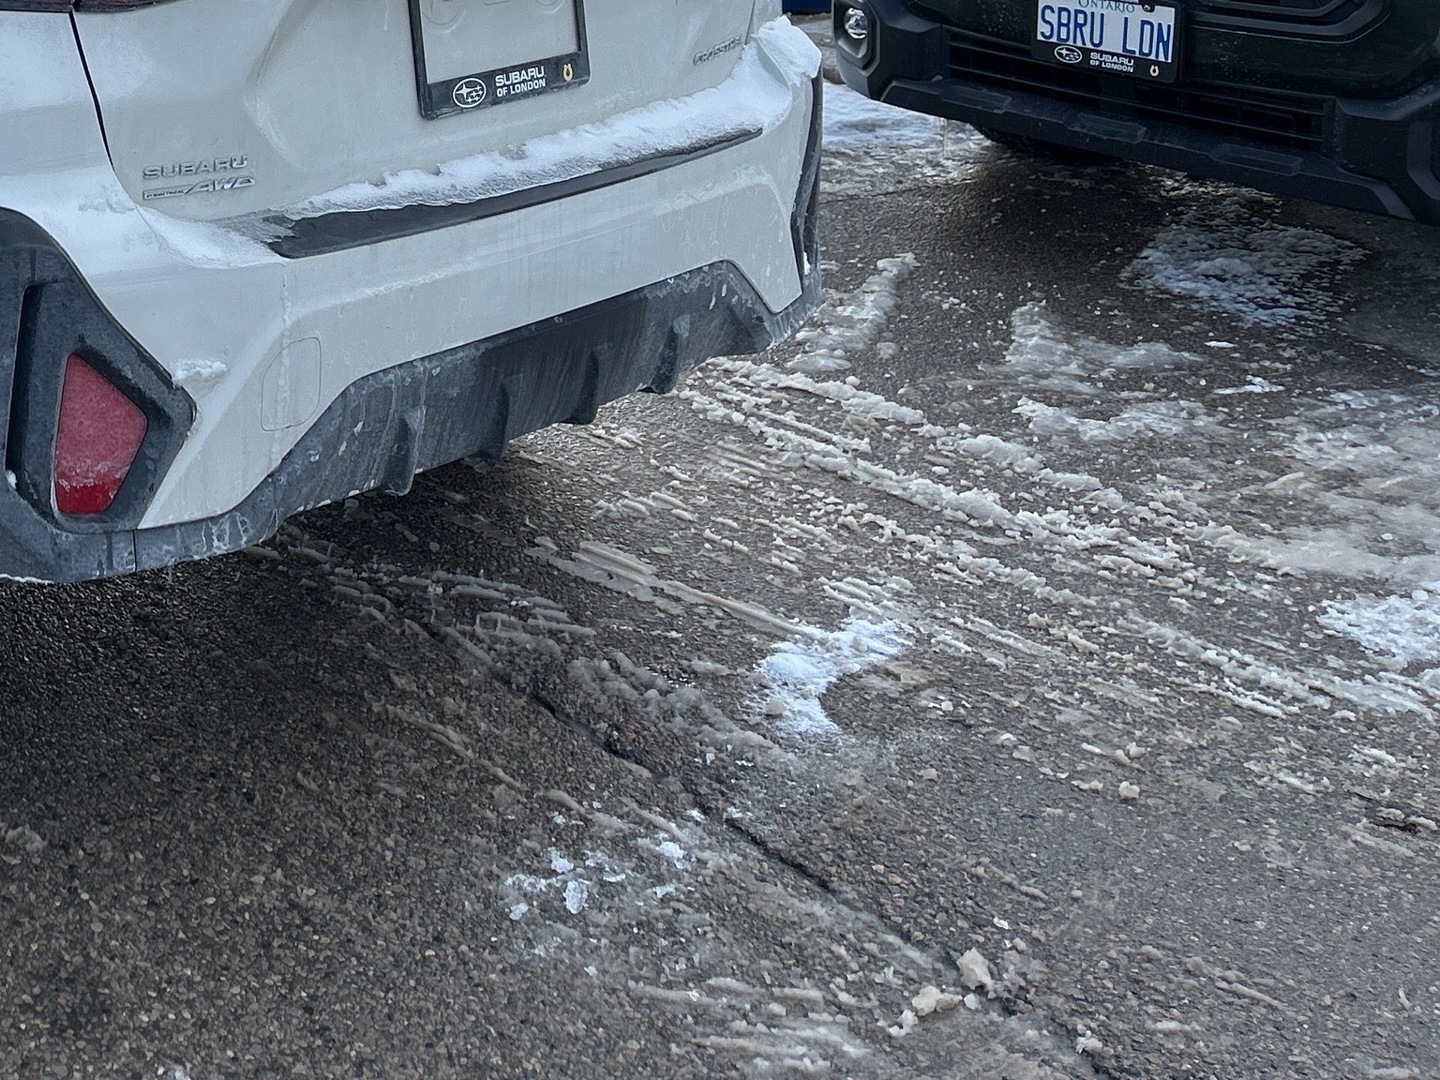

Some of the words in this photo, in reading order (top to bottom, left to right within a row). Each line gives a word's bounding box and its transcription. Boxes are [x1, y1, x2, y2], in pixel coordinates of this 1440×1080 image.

[1040, 4, 1105, 48] SBRU
[1122, 16, 1172, 61] LDN
[1089, 52, 1134, 67] SUBARU
[1089, 59, 1100, 67] OF
[1101, 61, 1134, 73] LONDON
[495, 66, 545, 87] SUBARU
[496, 87, 509, 98] OF
[510, 78, 546, 95] LONDON
[143, 155, 248, 180] SUBARU
[185, 176, 256, 195] AWD
